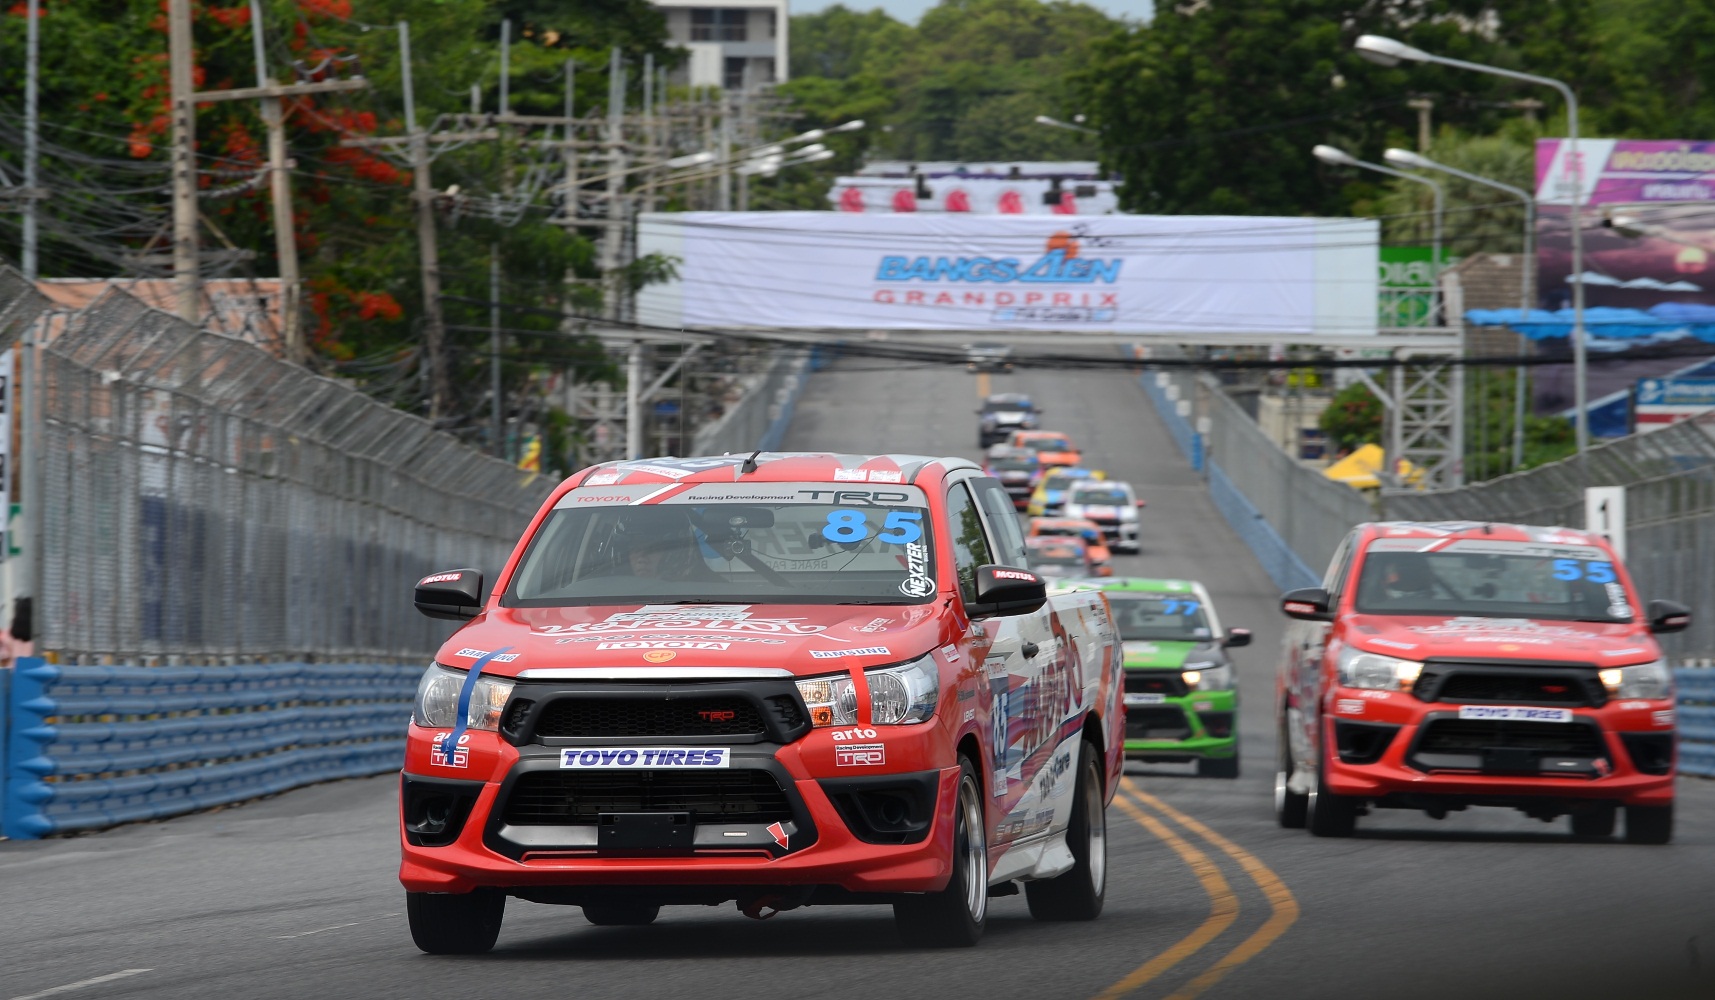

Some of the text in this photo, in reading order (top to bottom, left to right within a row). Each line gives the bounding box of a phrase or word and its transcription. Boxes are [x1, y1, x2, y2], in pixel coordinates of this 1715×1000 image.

[798, 490, 909, 507] TRD
[822, 509, 922, 544] 85
[906, 542, 926, 597] NEXZTER
[996, 570, 1035, 581] MOTUL
[1552, 559, 1616, 583] 55
[423, 573, 461, 584] MOTUL
[1162, 600, 1199, 616] 77
[603, 641, 725, 649] TOYOTA
[648, 652, 672, 660] CP
[813, 647, 887, 657] SAMSUNG
[698, 711, 734, 721] TRD
[831, 728, 877, 740] arto
[564, 749, 724, 766] TOYO TIRES
[838, 751, 882, 765] TRD
